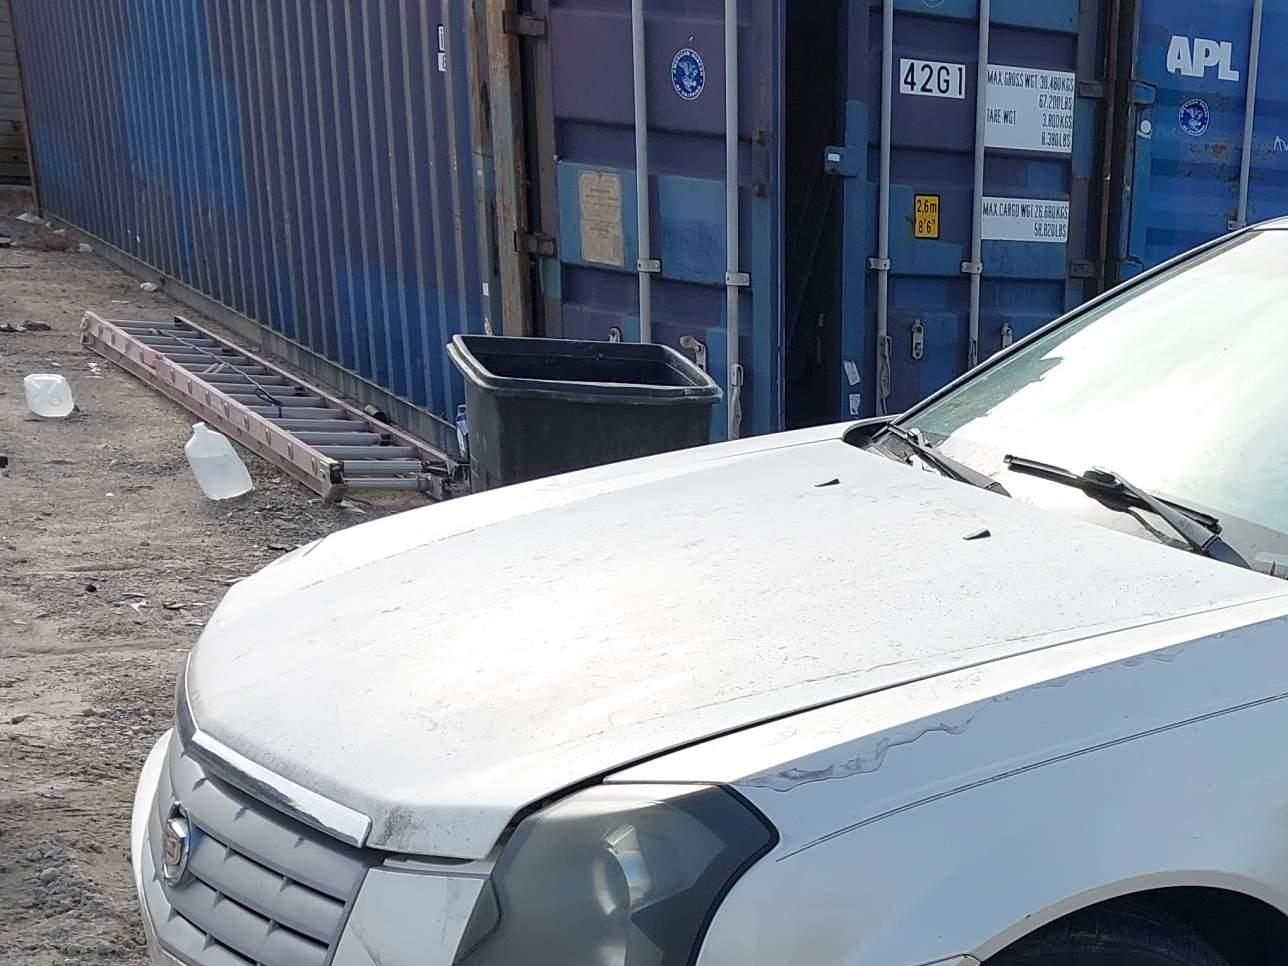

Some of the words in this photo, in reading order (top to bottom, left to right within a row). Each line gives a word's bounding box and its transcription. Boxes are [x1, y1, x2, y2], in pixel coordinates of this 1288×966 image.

[1167, 35, 1240, 81] APL
[904, 62, 963, 96] 42G1
[1004, 72, 1024, 88] GROSS
[987, 108, 1001, 123] TARE
